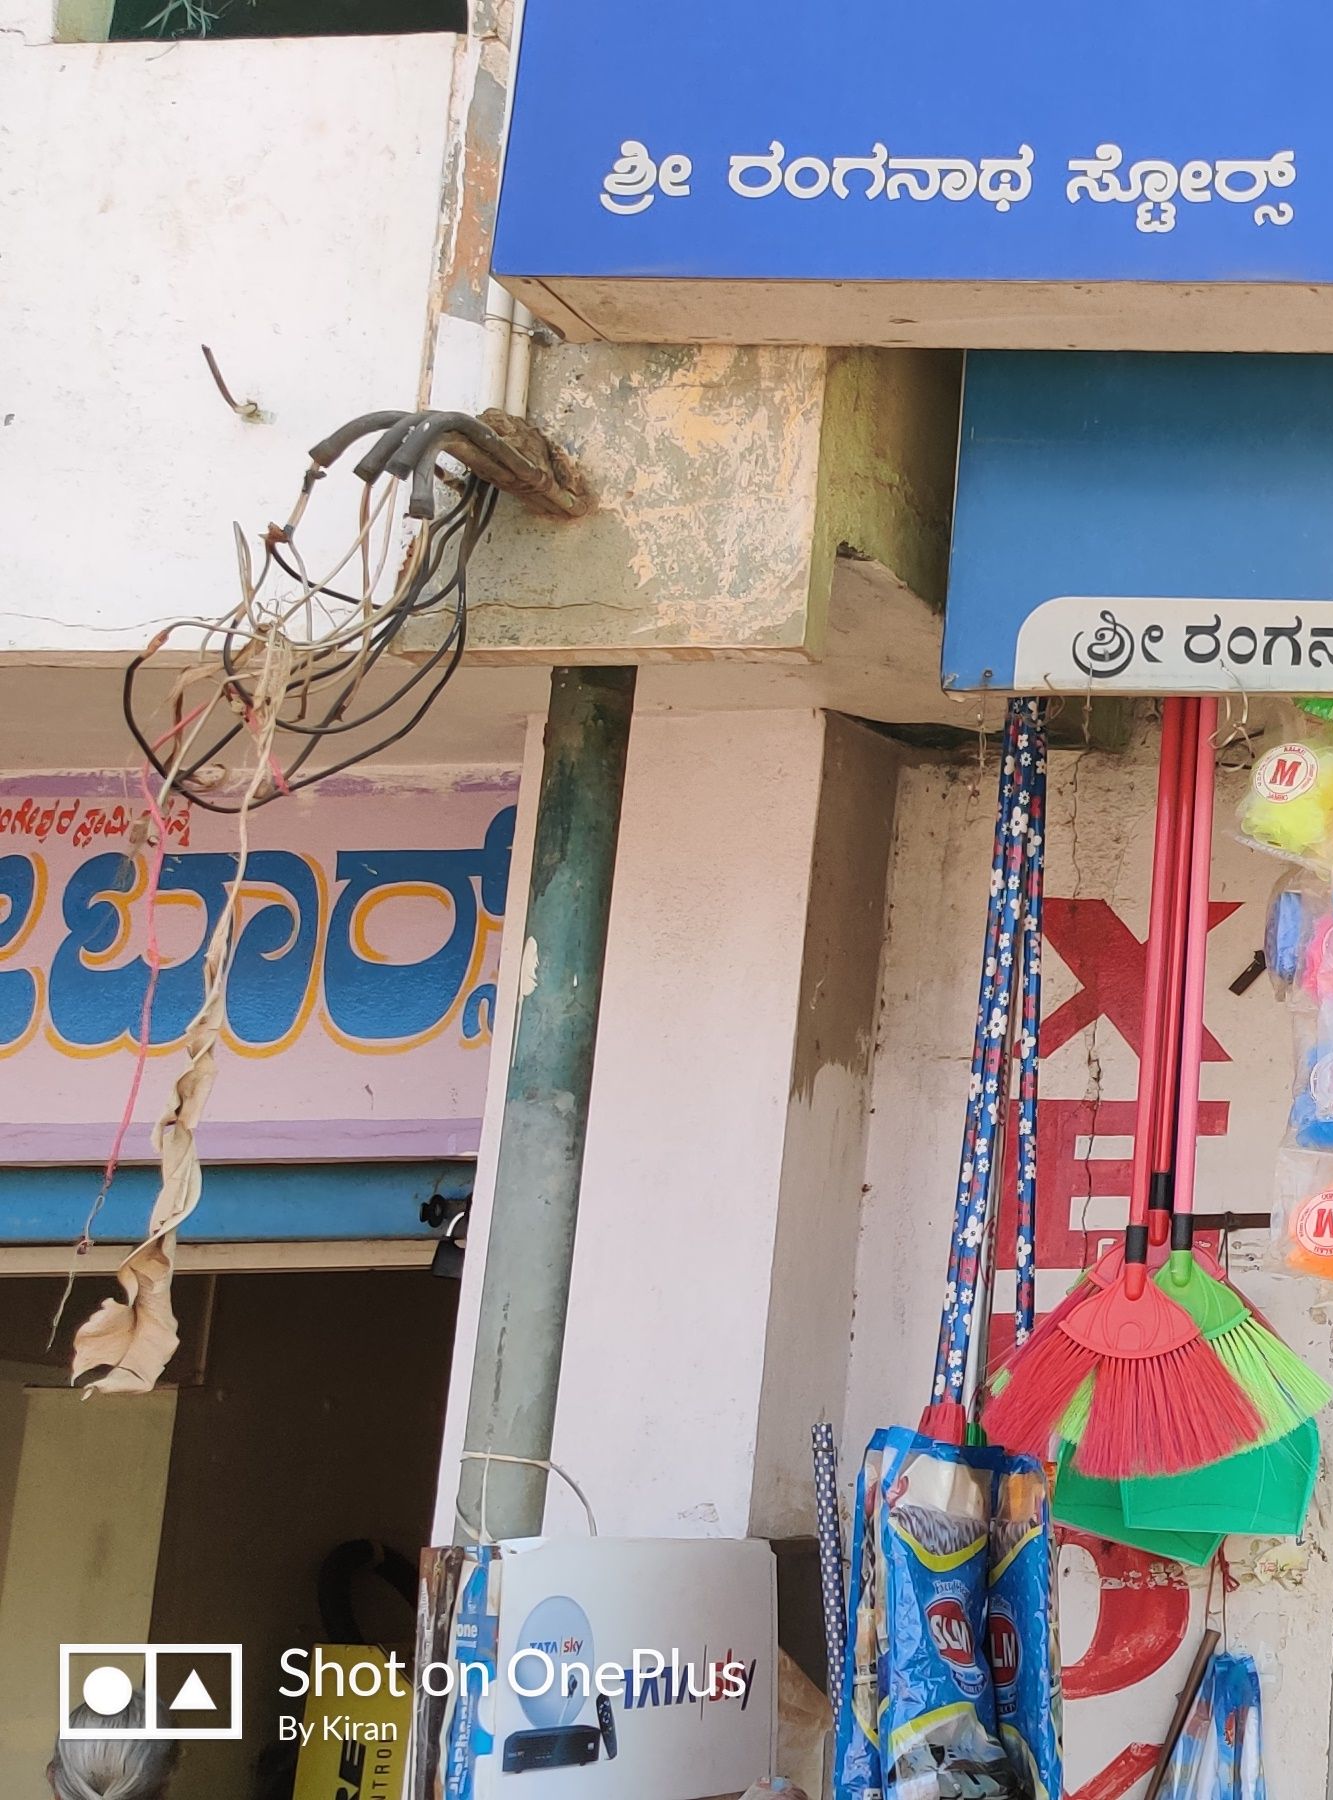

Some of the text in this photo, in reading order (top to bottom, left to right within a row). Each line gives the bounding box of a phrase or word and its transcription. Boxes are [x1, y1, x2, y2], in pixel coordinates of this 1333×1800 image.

[600, 140, 692, 216] ಶ್ರೀ
[728, 140, 1035, 213] ರಂಗನಾಥ
[1071, 610, 1163, 678] ಶ್ರೀ
[930, 1614, 972, 1655] SLM
[990, 1630, 1016, 1669] LM
